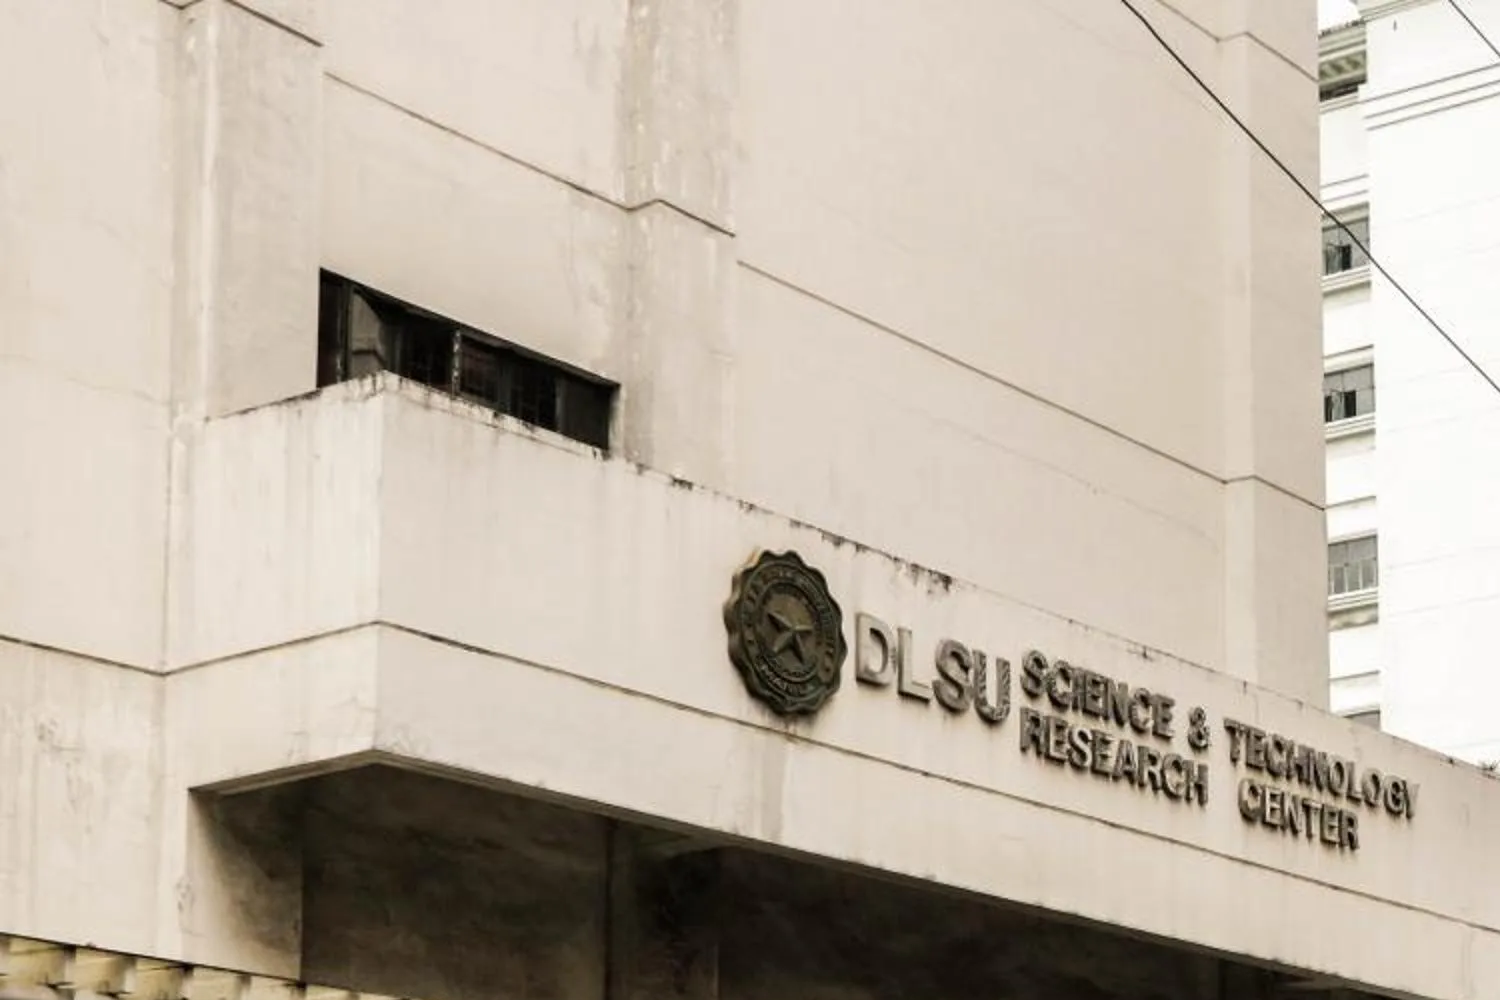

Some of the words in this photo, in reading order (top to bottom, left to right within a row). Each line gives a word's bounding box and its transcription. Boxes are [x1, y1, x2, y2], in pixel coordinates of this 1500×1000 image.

[855, 612, 1011, 727] DLSU
[1020, 650, 1175, 741] SCIENCE
[1188, 706, 1210, 751] &
[1223, 717, 1420, 820] TECHNOLOGY
[1020, 706, 1209, 806] RESEARCH
[1237, 777, 1360, 851] CENTER
